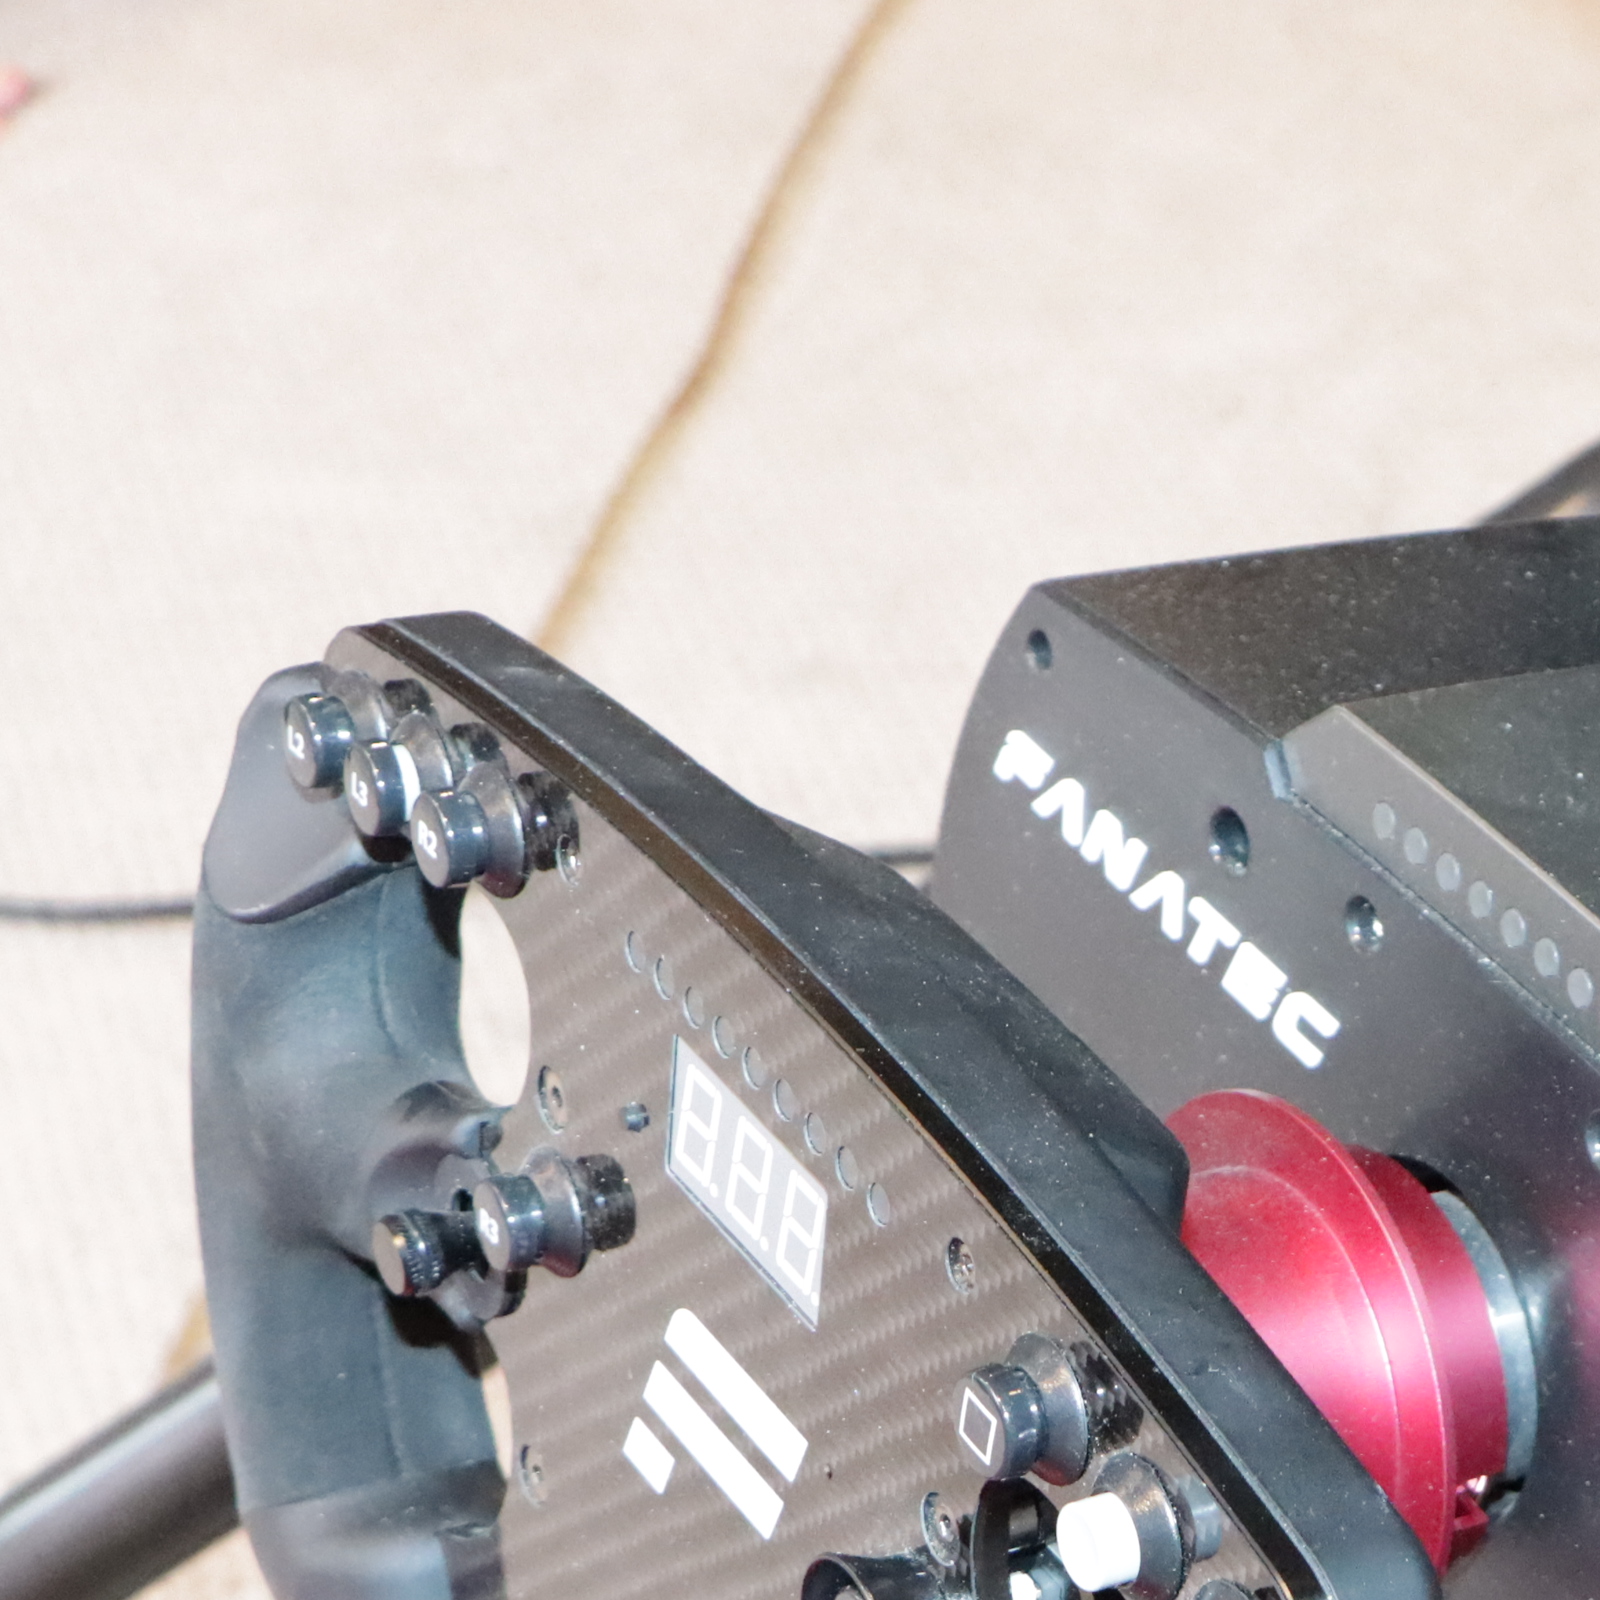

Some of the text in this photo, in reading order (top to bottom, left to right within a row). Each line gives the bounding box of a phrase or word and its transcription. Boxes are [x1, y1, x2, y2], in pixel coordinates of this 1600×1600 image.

[285, 724, 306, 761] L2
[349, 771, 369, 808] L3
[416, 819, 438, 860] R2
[993, 729, 1341, 1069] FANATEC
